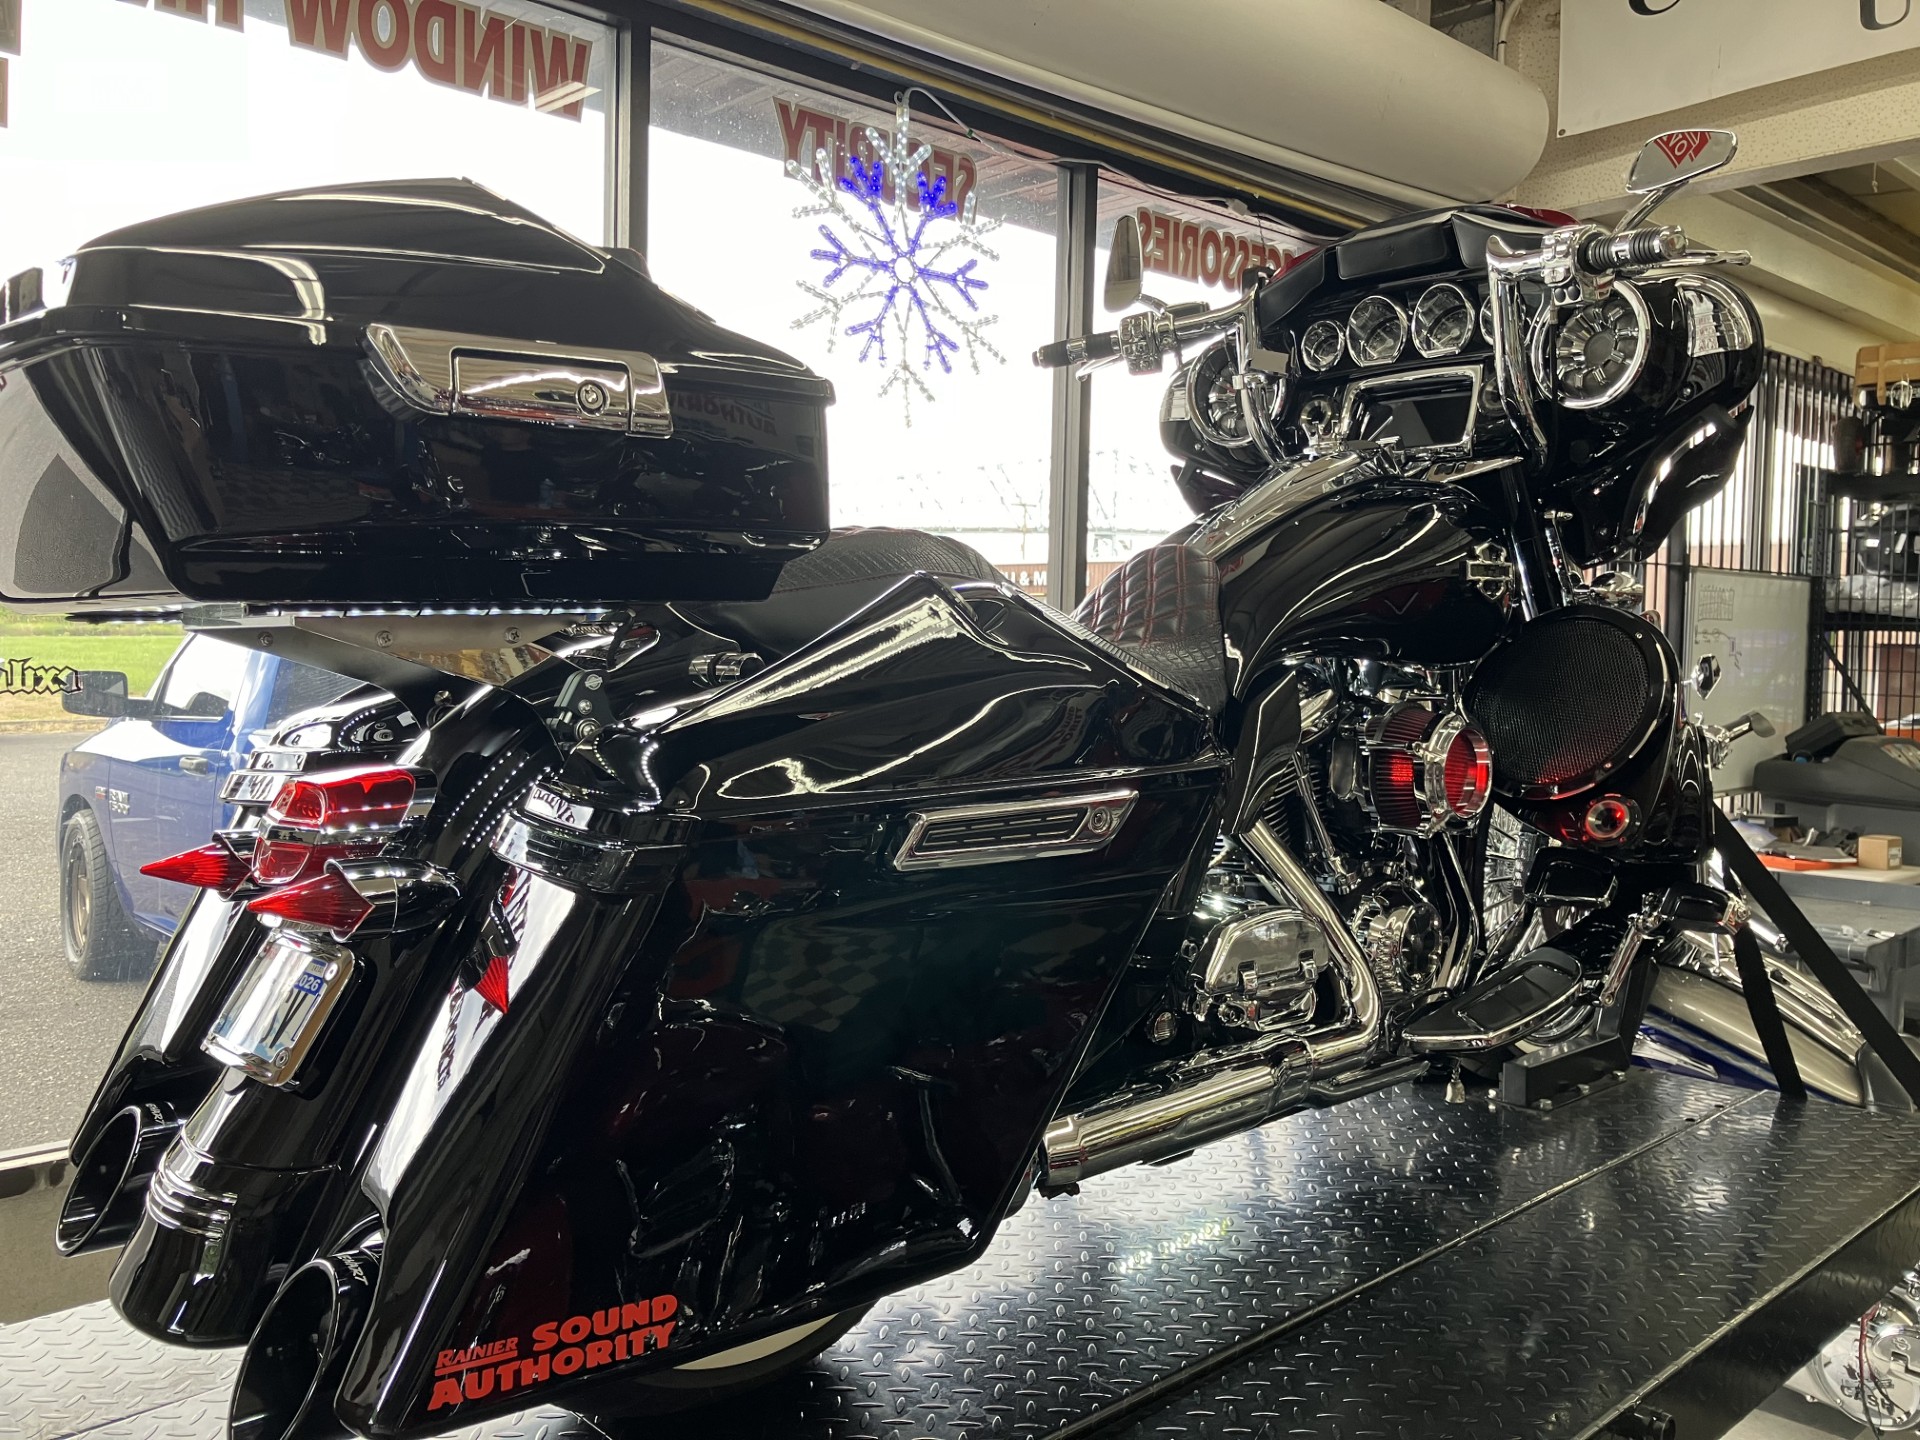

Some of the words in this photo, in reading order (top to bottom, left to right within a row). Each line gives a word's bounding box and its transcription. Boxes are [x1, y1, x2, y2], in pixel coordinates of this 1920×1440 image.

[427, 1321, 677, 1411] AUTHORITY
[435, 1337, 518, 1370] RAINIER
[532, 1294, 678, 1352] SOUND
